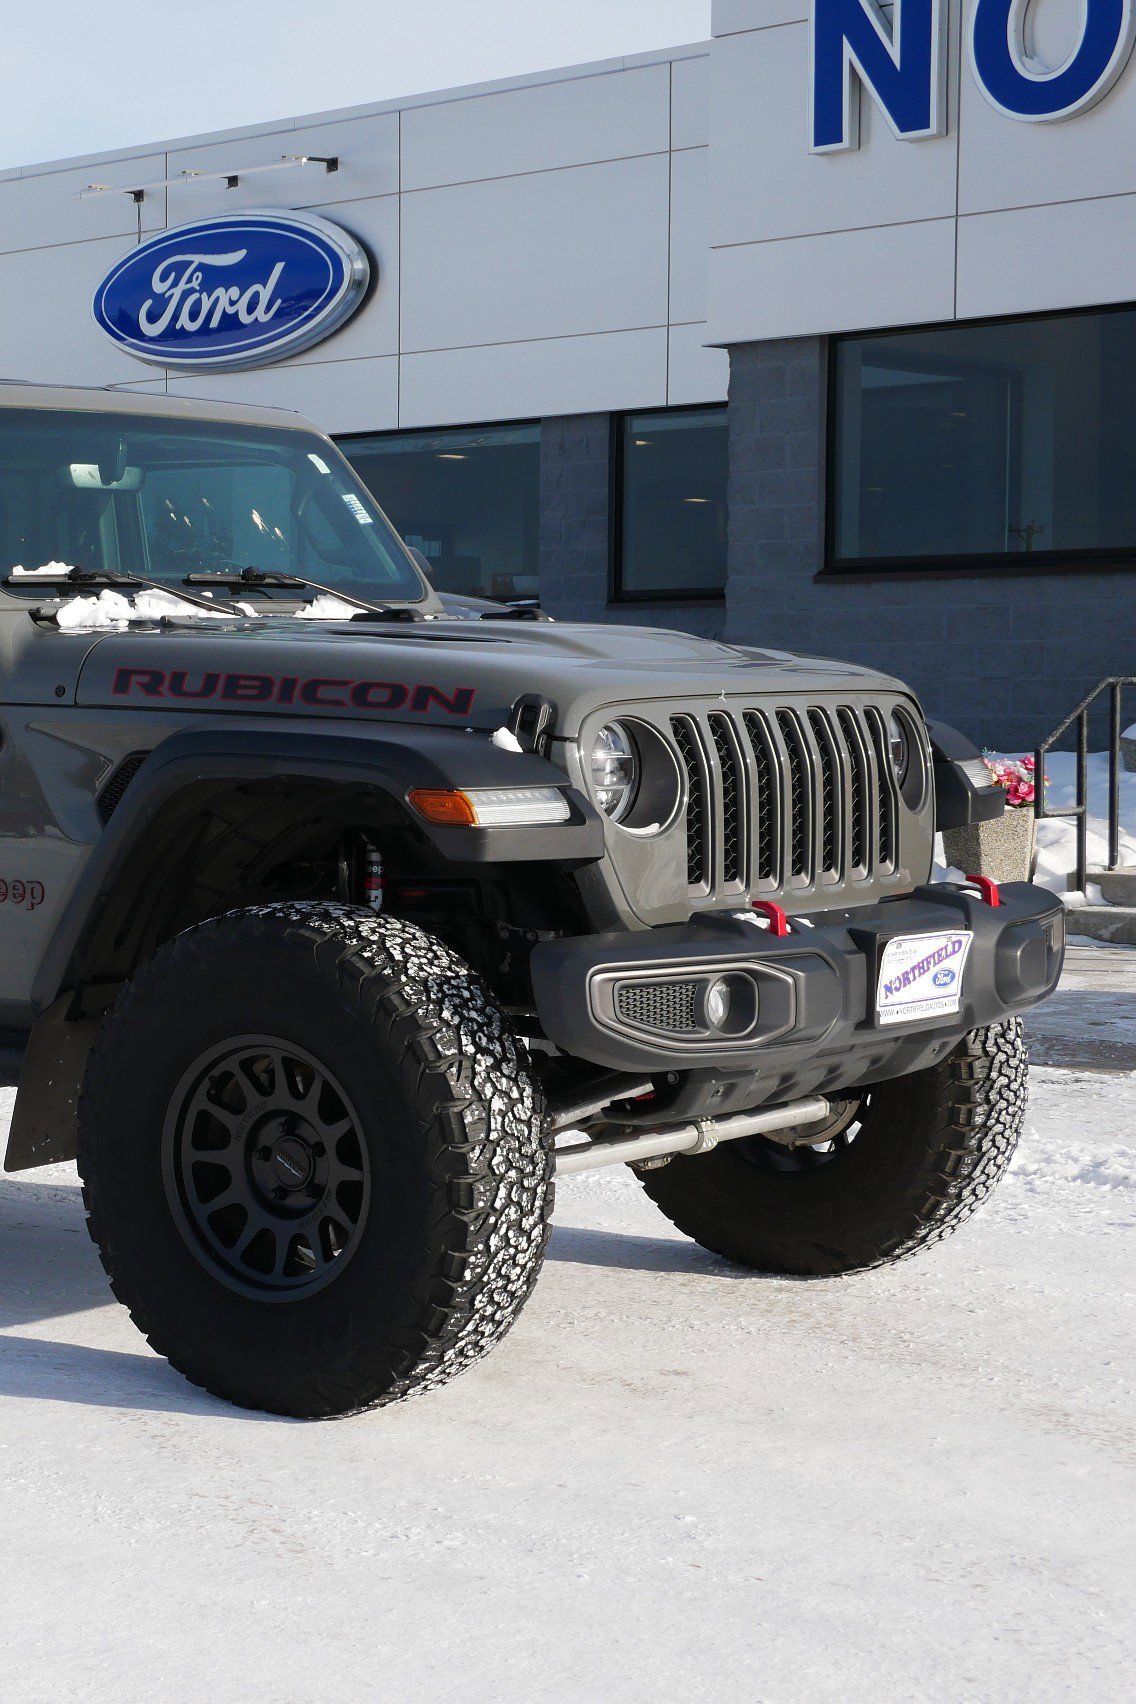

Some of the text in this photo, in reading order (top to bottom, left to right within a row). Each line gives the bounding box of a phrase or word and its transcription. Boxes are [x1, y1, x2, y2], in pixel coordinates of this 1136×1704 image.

[139, 249, 285, 336] Ford
[111, 667, 476, 717] RUBICON
[884, 939, 963, 999] NORTHFIELD
